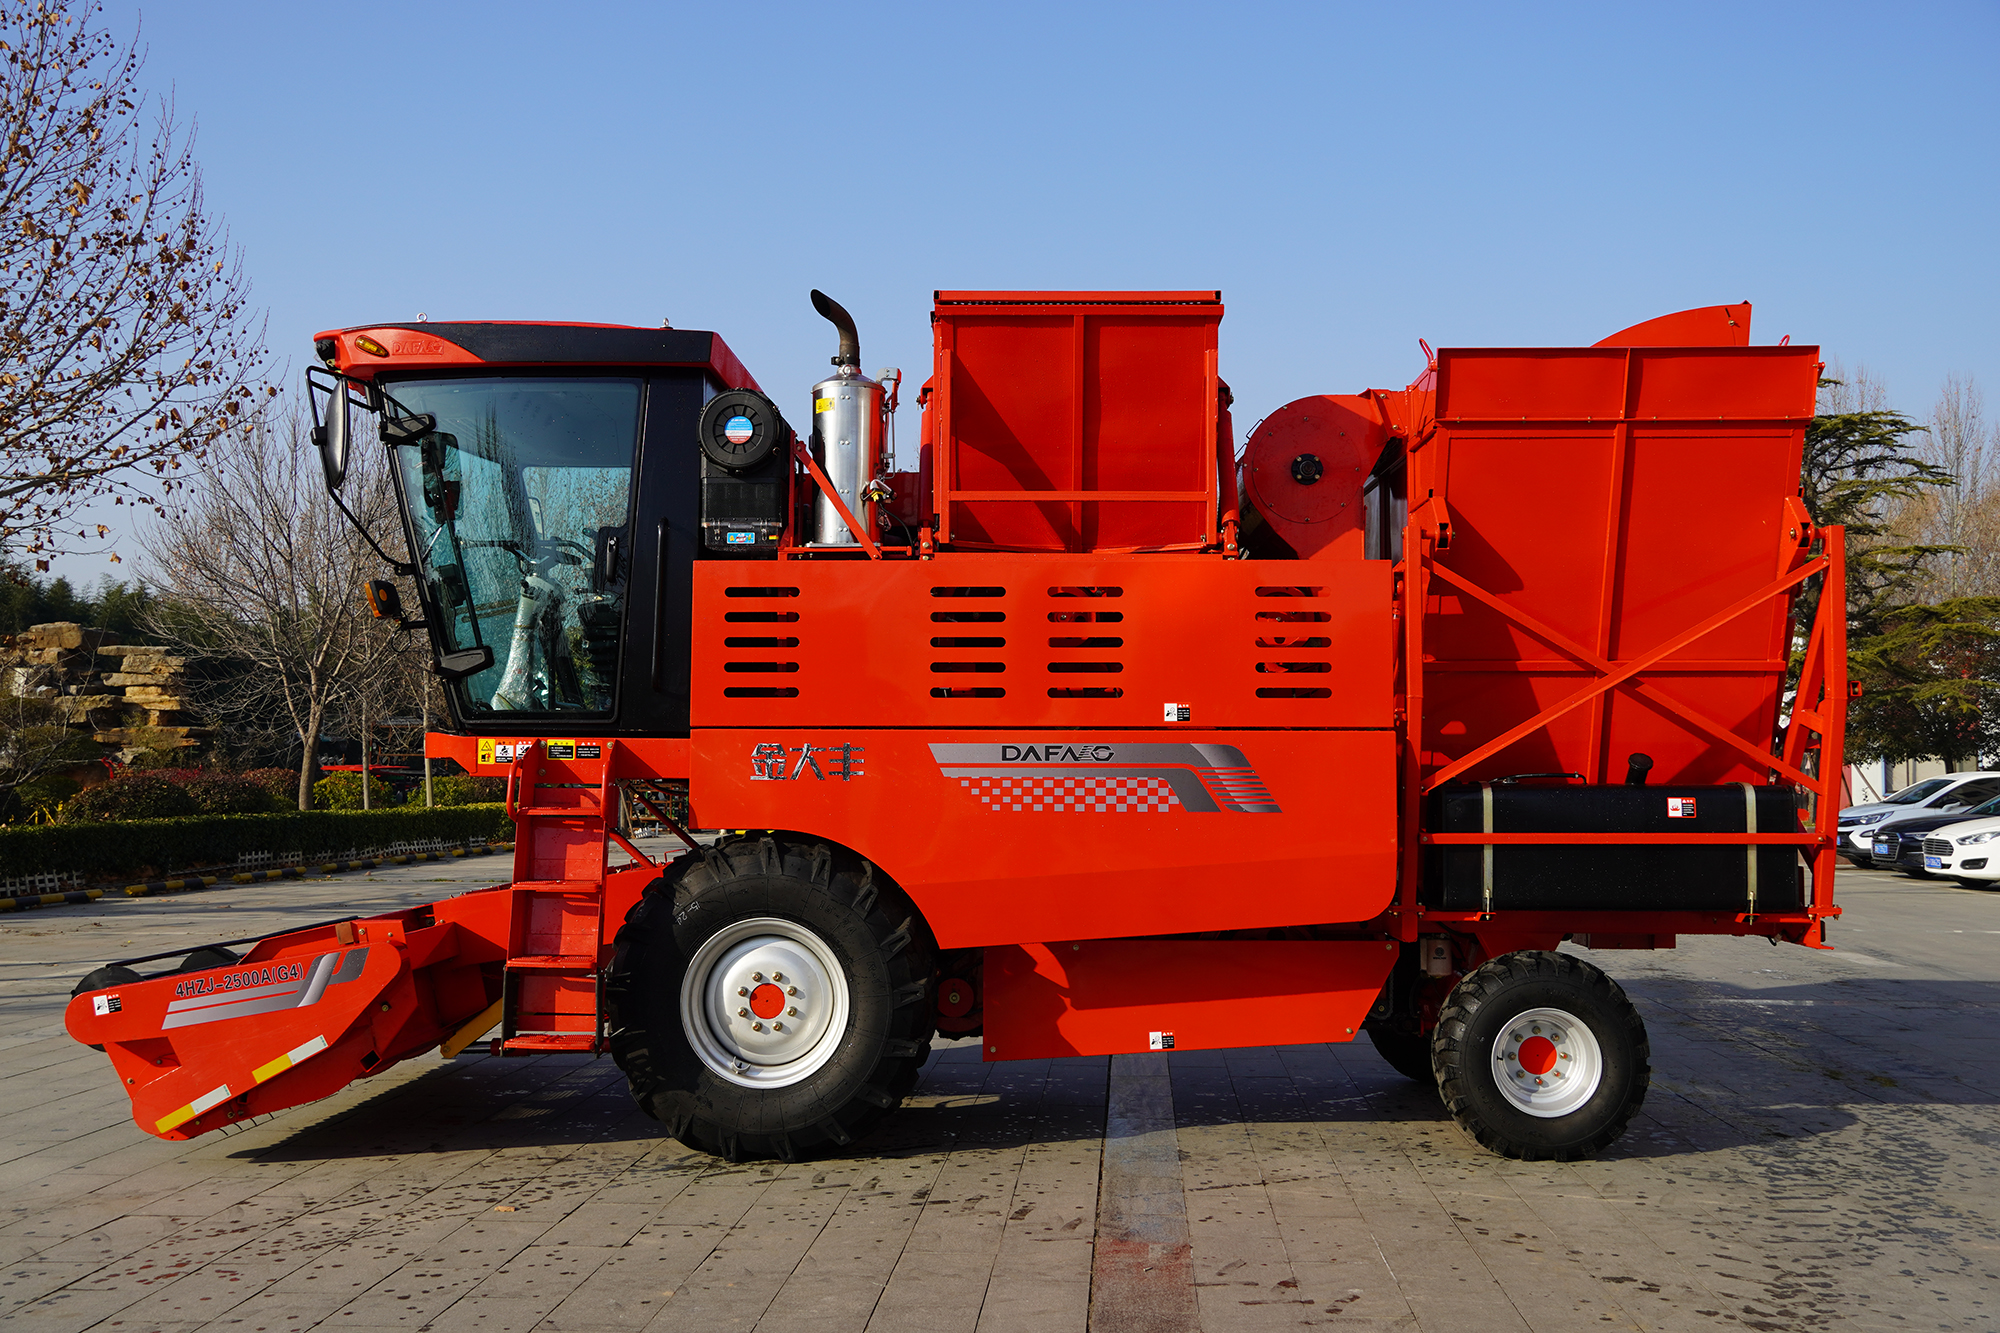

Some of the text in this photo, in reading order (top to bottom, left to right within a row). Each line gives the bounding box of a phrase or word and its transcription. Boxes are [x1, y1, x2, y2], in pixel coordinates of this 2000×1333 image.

[750, 743, 865, 781] 金大丰
[175, 963, 304, 997] 4HZJ-2500A(G4)
